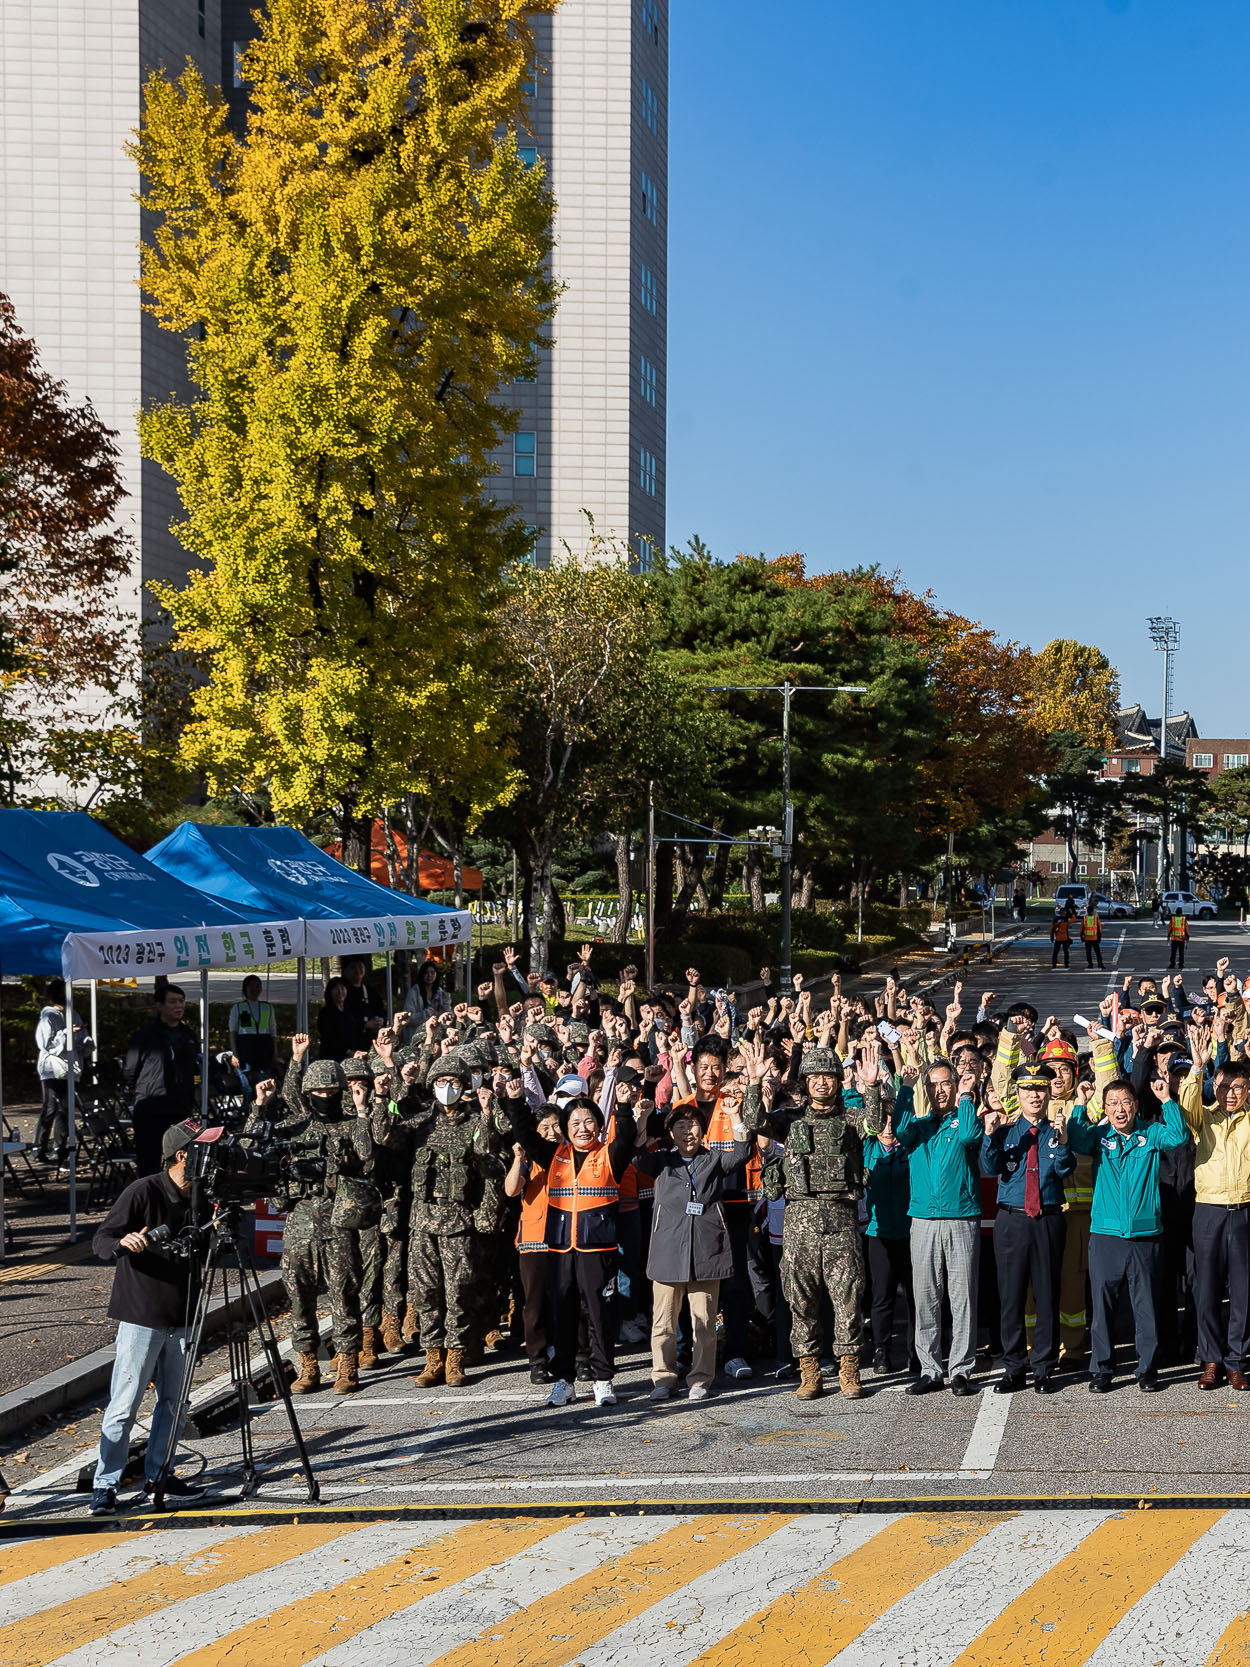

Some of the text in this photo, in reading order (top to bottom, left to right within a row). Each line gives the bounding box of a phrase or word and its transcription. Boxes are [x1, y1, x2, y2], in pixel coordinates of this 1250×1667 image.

[99, 943, 131, 965] 2023
[135, 941, 166, 965] 광진구
[221, 931, 255, 963] 한국
[262, 927, 292, 958] 훈련
[329, 927, 351, 945] 2023
[350, 926, 372, 944] 광진구
[405, 920, 430, 945] 한국
[438, 917, 462, 942] 훈련
